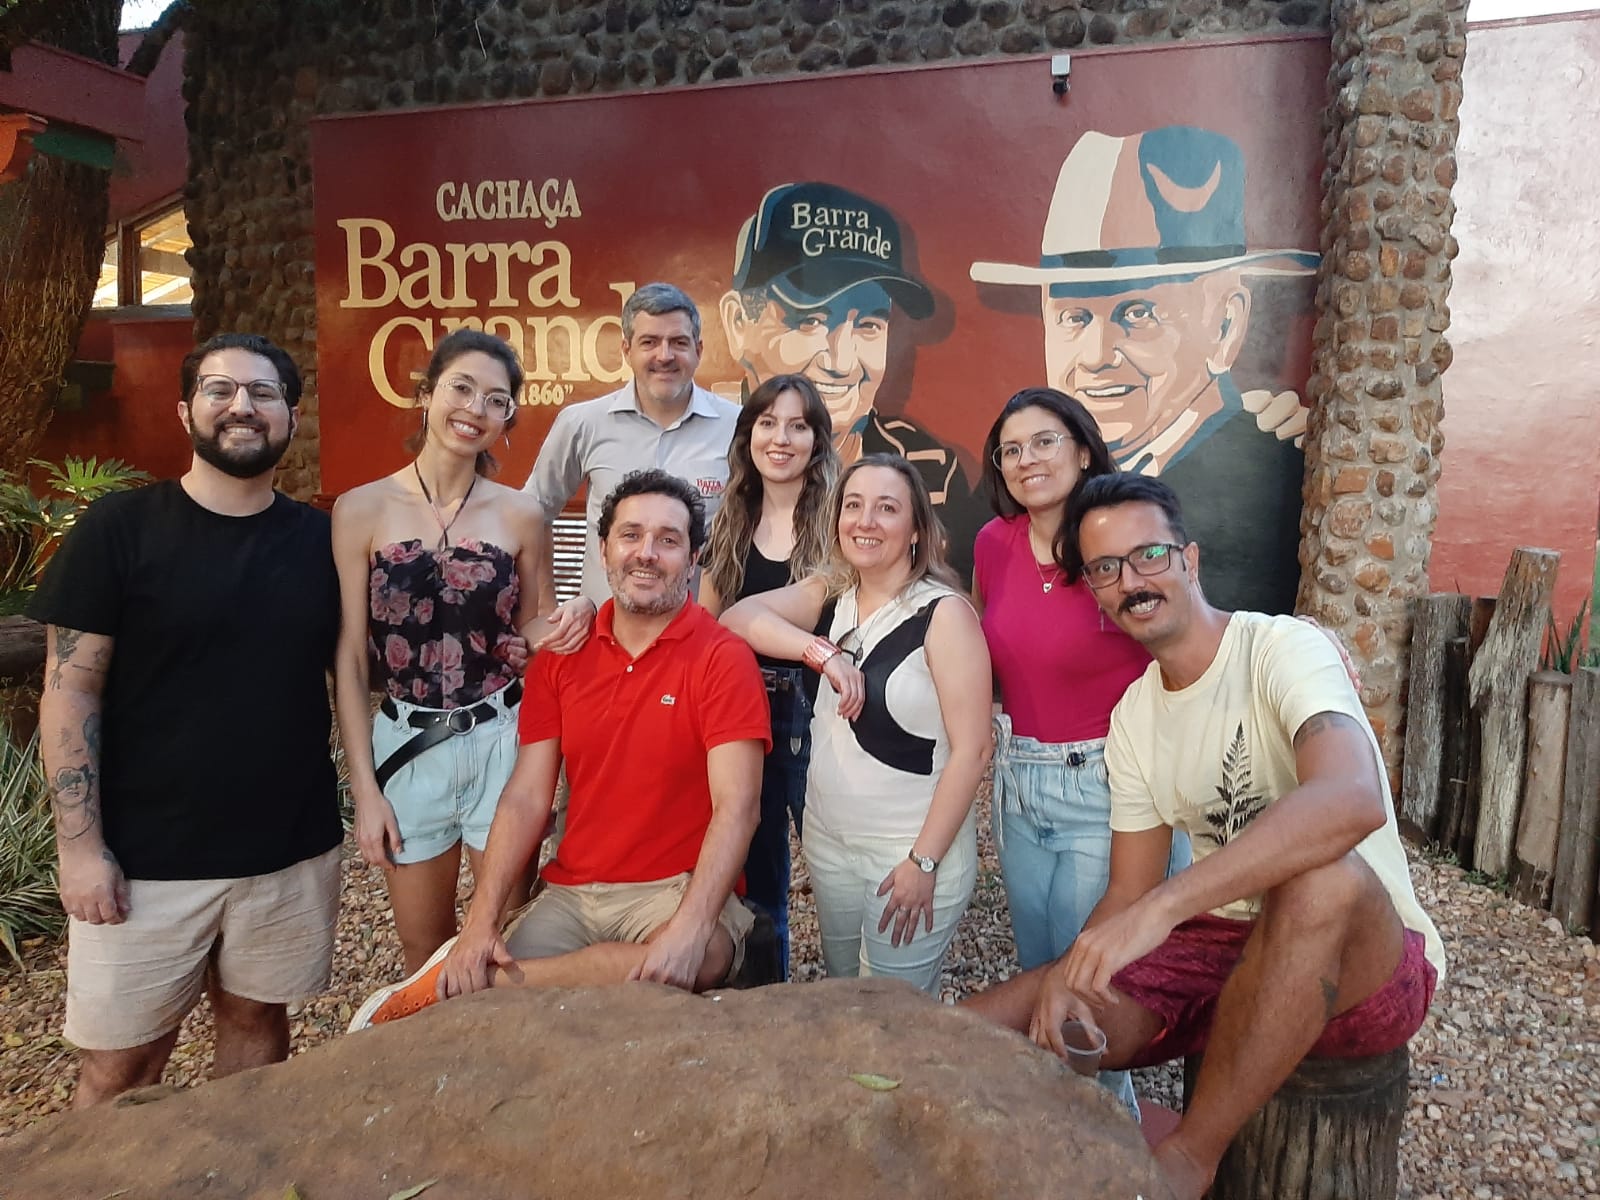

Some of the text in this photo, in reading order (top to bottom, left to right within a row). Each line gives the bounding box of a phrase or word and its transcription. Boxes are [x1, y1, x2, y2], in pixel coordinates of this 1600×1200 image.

[436, 178, 582, 229] CACHAÇA
[790, 202, 869, 229] Barra
[337, 218, 581, 309] Barra
[802, 226, 892, 260] Grande
